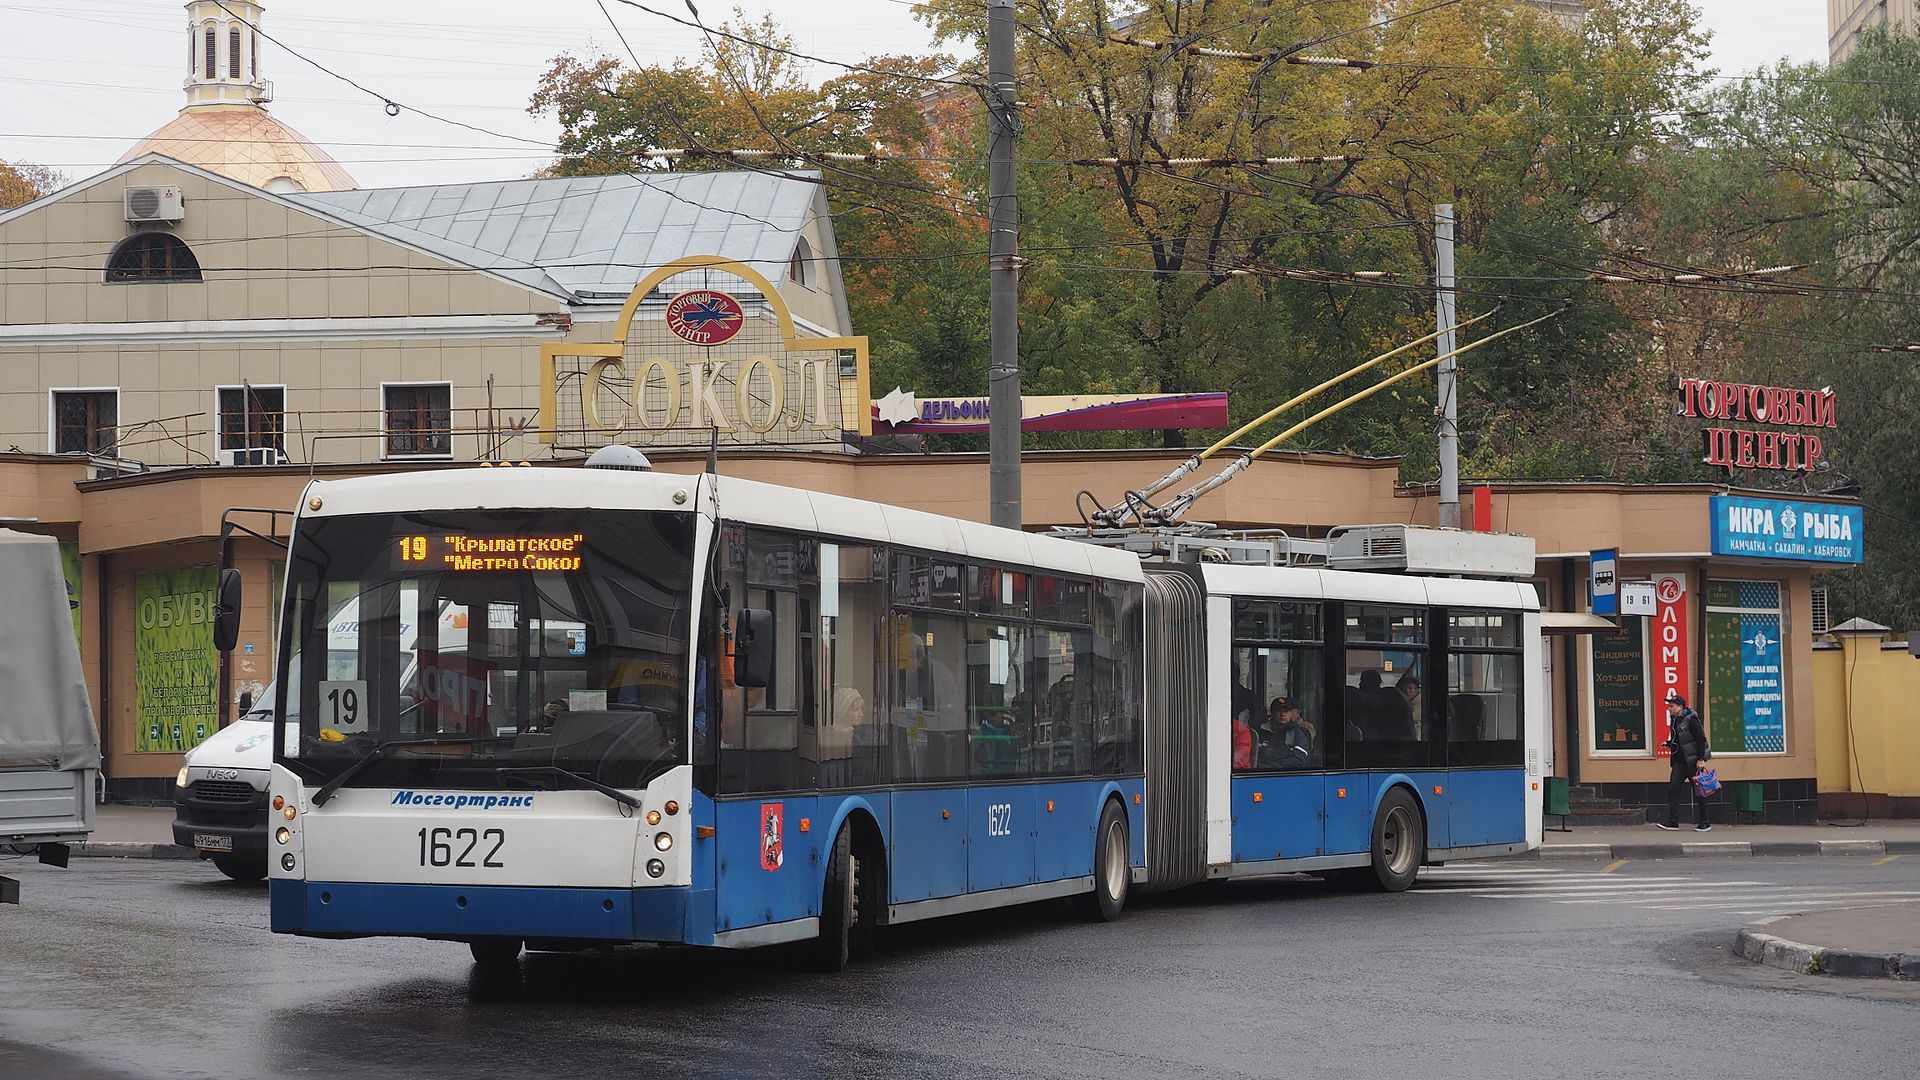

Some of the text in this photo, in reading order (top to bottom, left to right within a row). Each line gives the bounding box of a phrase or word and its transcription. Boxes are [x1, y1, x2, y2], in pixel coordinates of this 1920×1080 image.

[669, 291, 711, 317] ТОРГОВЫЙ
[671, 318, 711, 342] ЦЕНТР
[584, 355, 834, 436] СОКОЛ
[1680, 378, 1837, 428] ТОРГОВЫЙ
[1704, 428, 1822, 478] ЦЕНТР
[1729, 506, 1852, 540] ИКРА РЫБА
[400, 536, 427, 560] 19
[445, 534, 583, 552] "Крылатское"
[1730, 539, 1851, 558] КАМЧАТКА САХАЛИН ХАБАРОВСК
[1626, 595, 1650, 605] 19 61
[153, 648, 206, 664] РОССИЙСКИХ
[1594, 650, 1641, 660] Сандвичи
[1596, 673, 1639, 682] Хот-доги
[1662, 606, 1680, 741] ЛОМБА
[153, 685, 209, 699] БЕЛОРУССКИХ
[145, 703, 217, 717] ПРОИЗВОДИТЕЛЕЙ
[328, 688, 358, 725] 19
[1598, 698, 1640, 708] Выпечка
[206, 769, 239, 780] IVECO
[391, 791, 533, 809] Мосгортранс
[987, 804, 1012, 837] 1622
[418, 827, 505, 867] 1622
